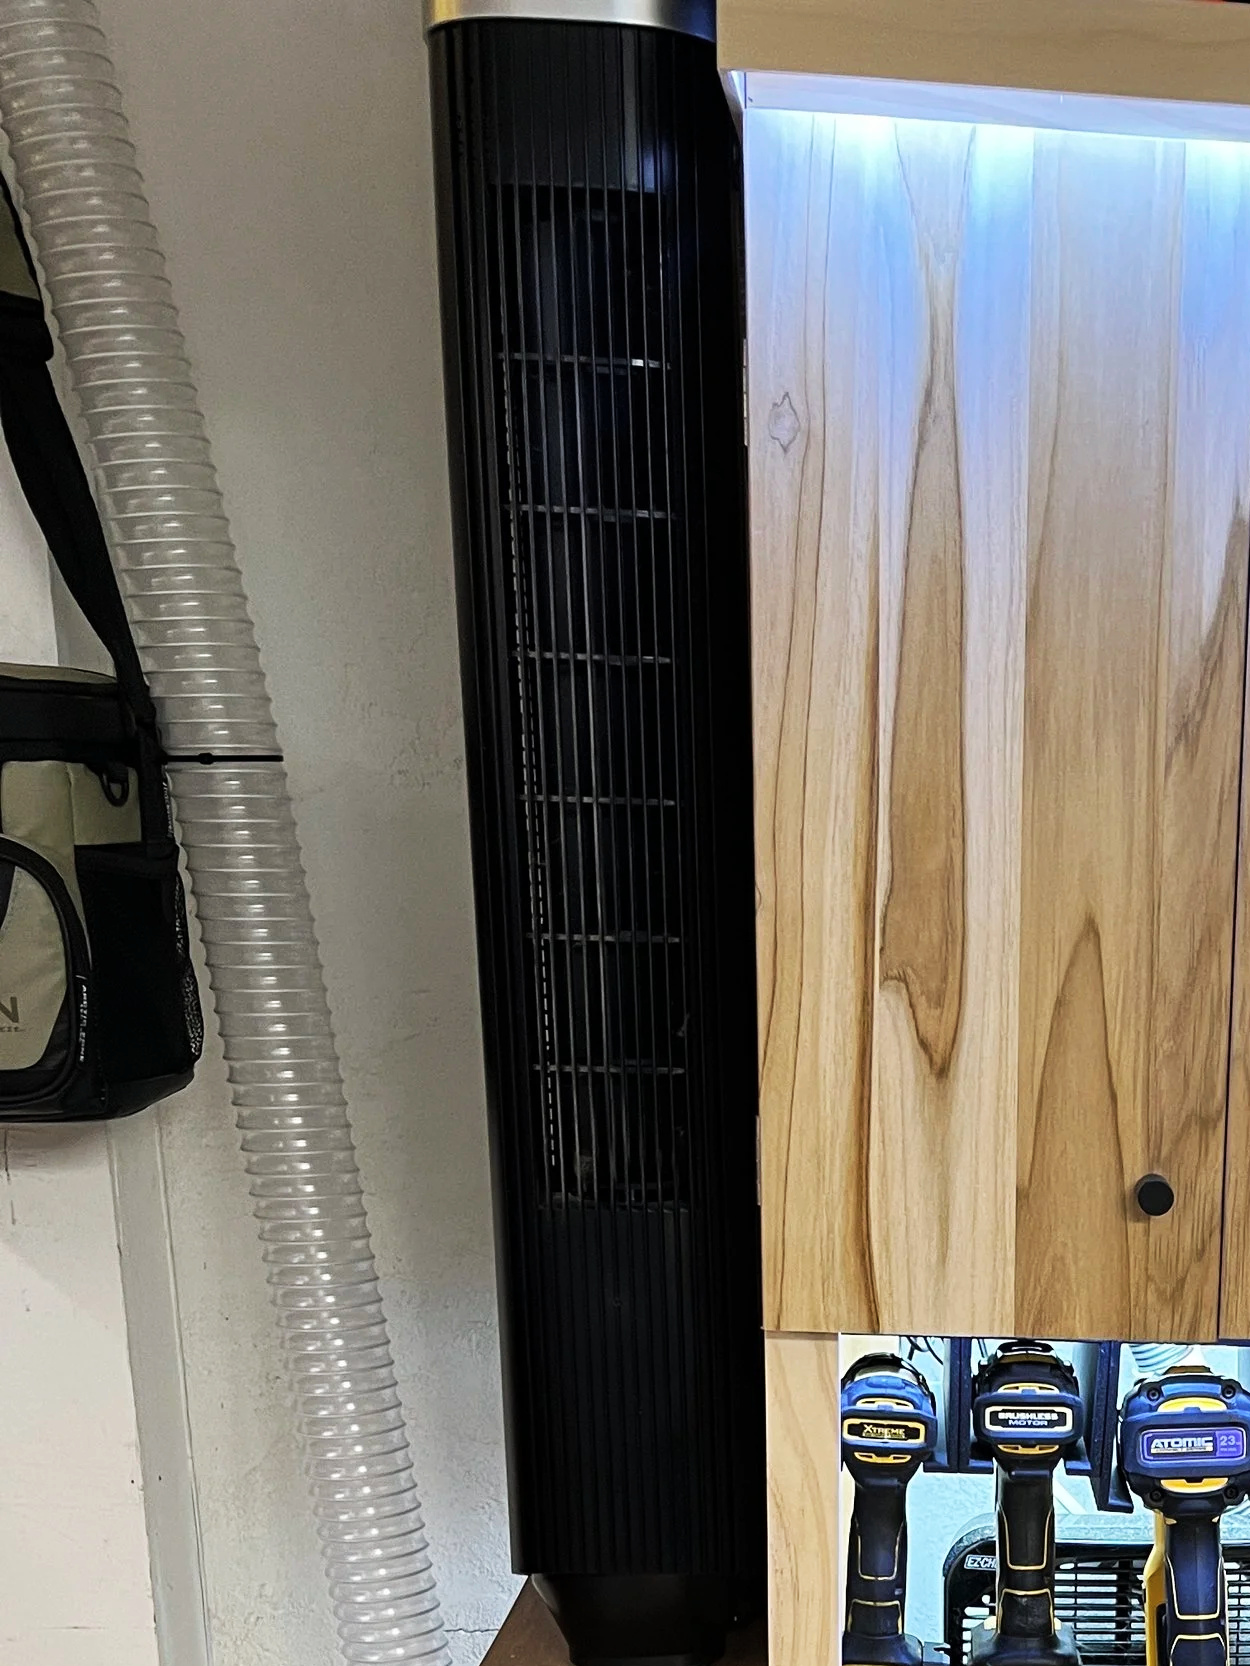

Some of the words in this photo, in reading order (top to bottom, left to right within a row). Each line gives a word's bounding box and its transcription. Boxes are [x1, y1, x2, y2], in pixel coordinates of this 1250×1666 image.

[998, 1412, 1059, 1420] BRUSHLESS
[1152, 1437, 1213, 1448] ATOMIC
[1219, 1435, 1236, 1446] 23
[967, 1557, 996, 1568] EZ-CH
